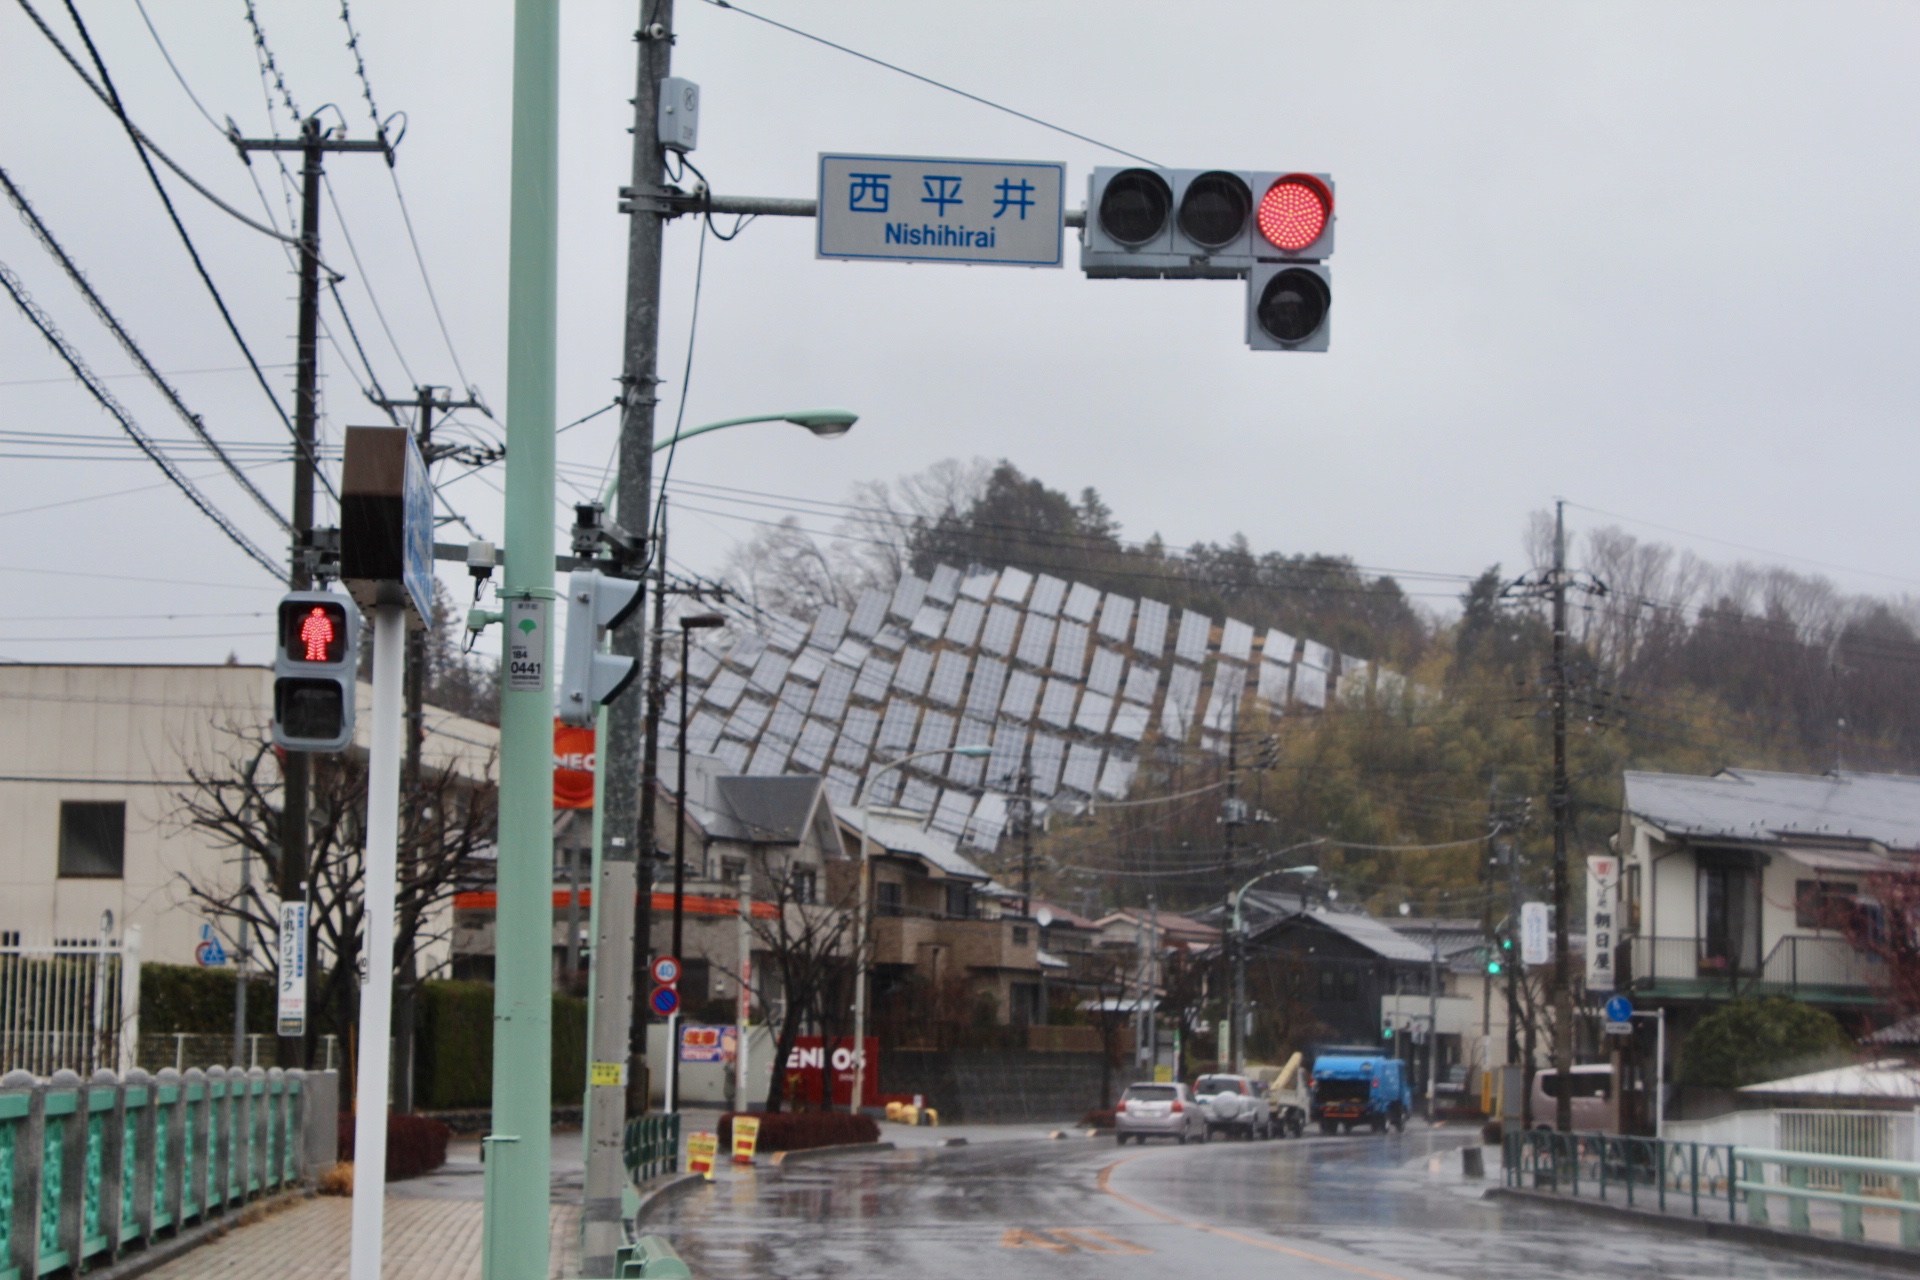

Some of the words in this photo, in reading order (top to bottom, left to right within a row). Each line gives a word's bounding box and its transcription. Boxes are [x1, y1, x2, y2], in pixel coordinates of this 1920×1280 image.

[849, 172, 1036, 220] 西平井
[884, 222, 996, 249] Nishihirai
[512, 650, 528, 659] 184
[510, 661, 541, 674] 0441
[657, 963, 674, 977] 40
